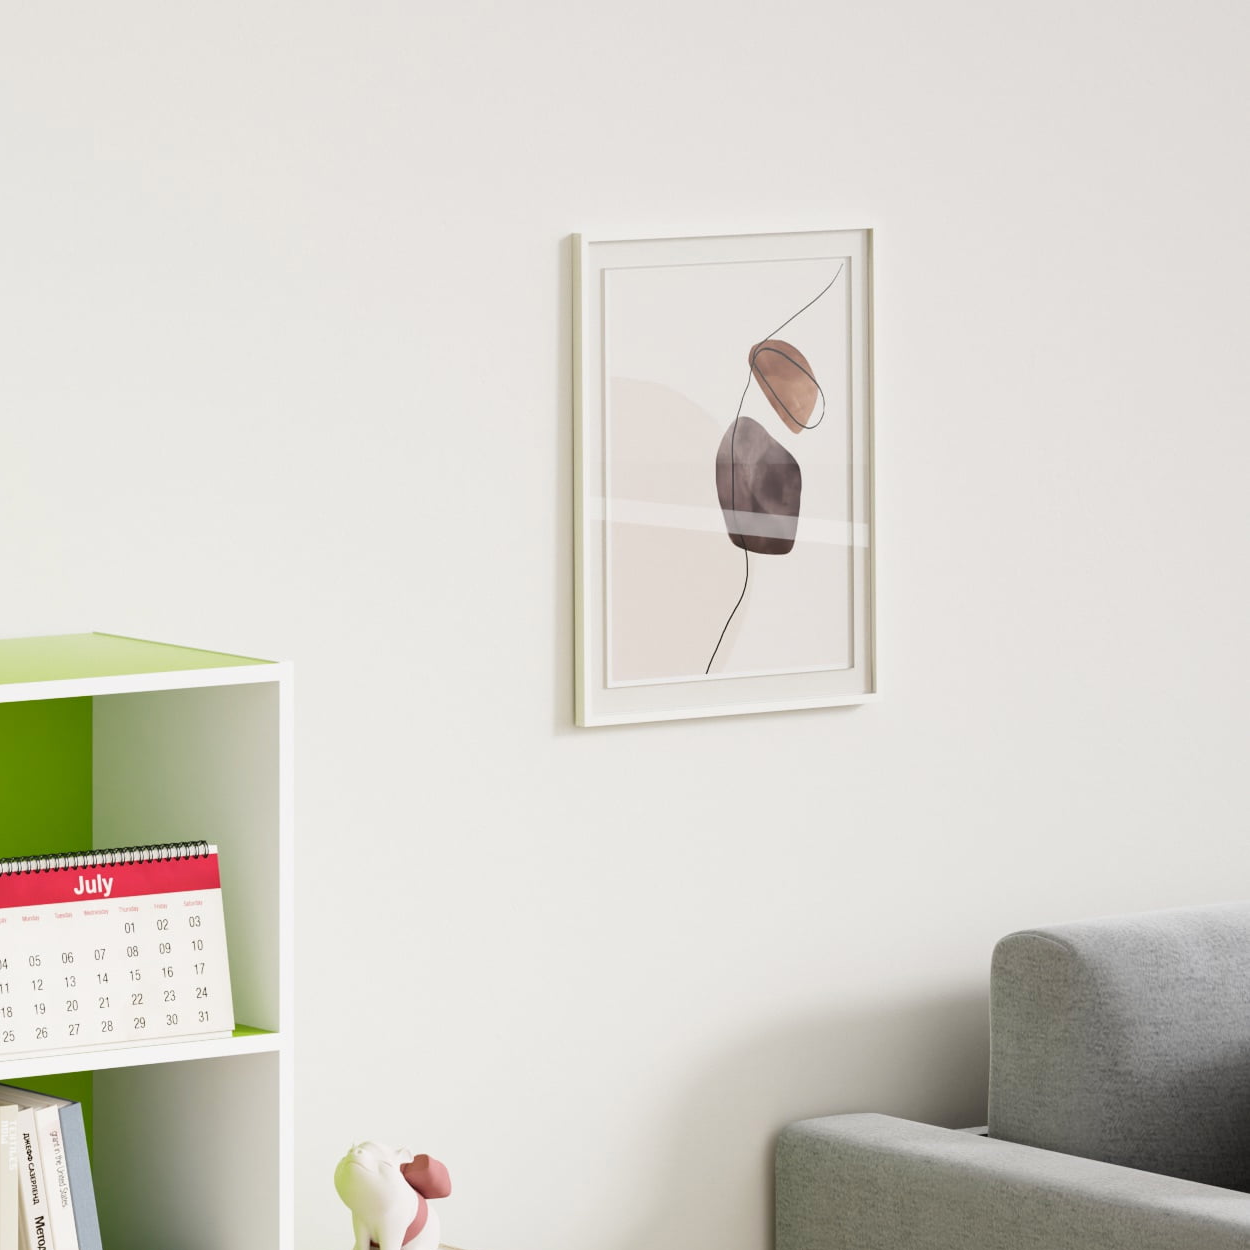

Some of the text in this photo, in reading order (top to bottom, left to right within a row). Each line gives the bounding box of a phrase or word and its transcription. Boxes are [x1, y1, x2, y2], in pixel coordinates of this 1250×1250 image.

[73, 874, 114, 897] July
[124, 916, 201, 934] 01 02 03
[28, 955, 41, 967] 05
[61, 952, 74, 964] 06
[94, 949, 106, 961] 07
[126, 946, 139, 958] 08
[159, 942, 171, 955] 09
[191, 939, 203, 952] 10
[0, 963, 205, 994] 11 12 13 14 15 16 17
[1, 987, 208, 1019] 18 19 20 21 22 23 24
[3, 1011, 209, 1043] 25 26 27 28 29 30 31
[23, 1133, 40, 1205] ДЖЕФФ САЗЕРЛЕНД
